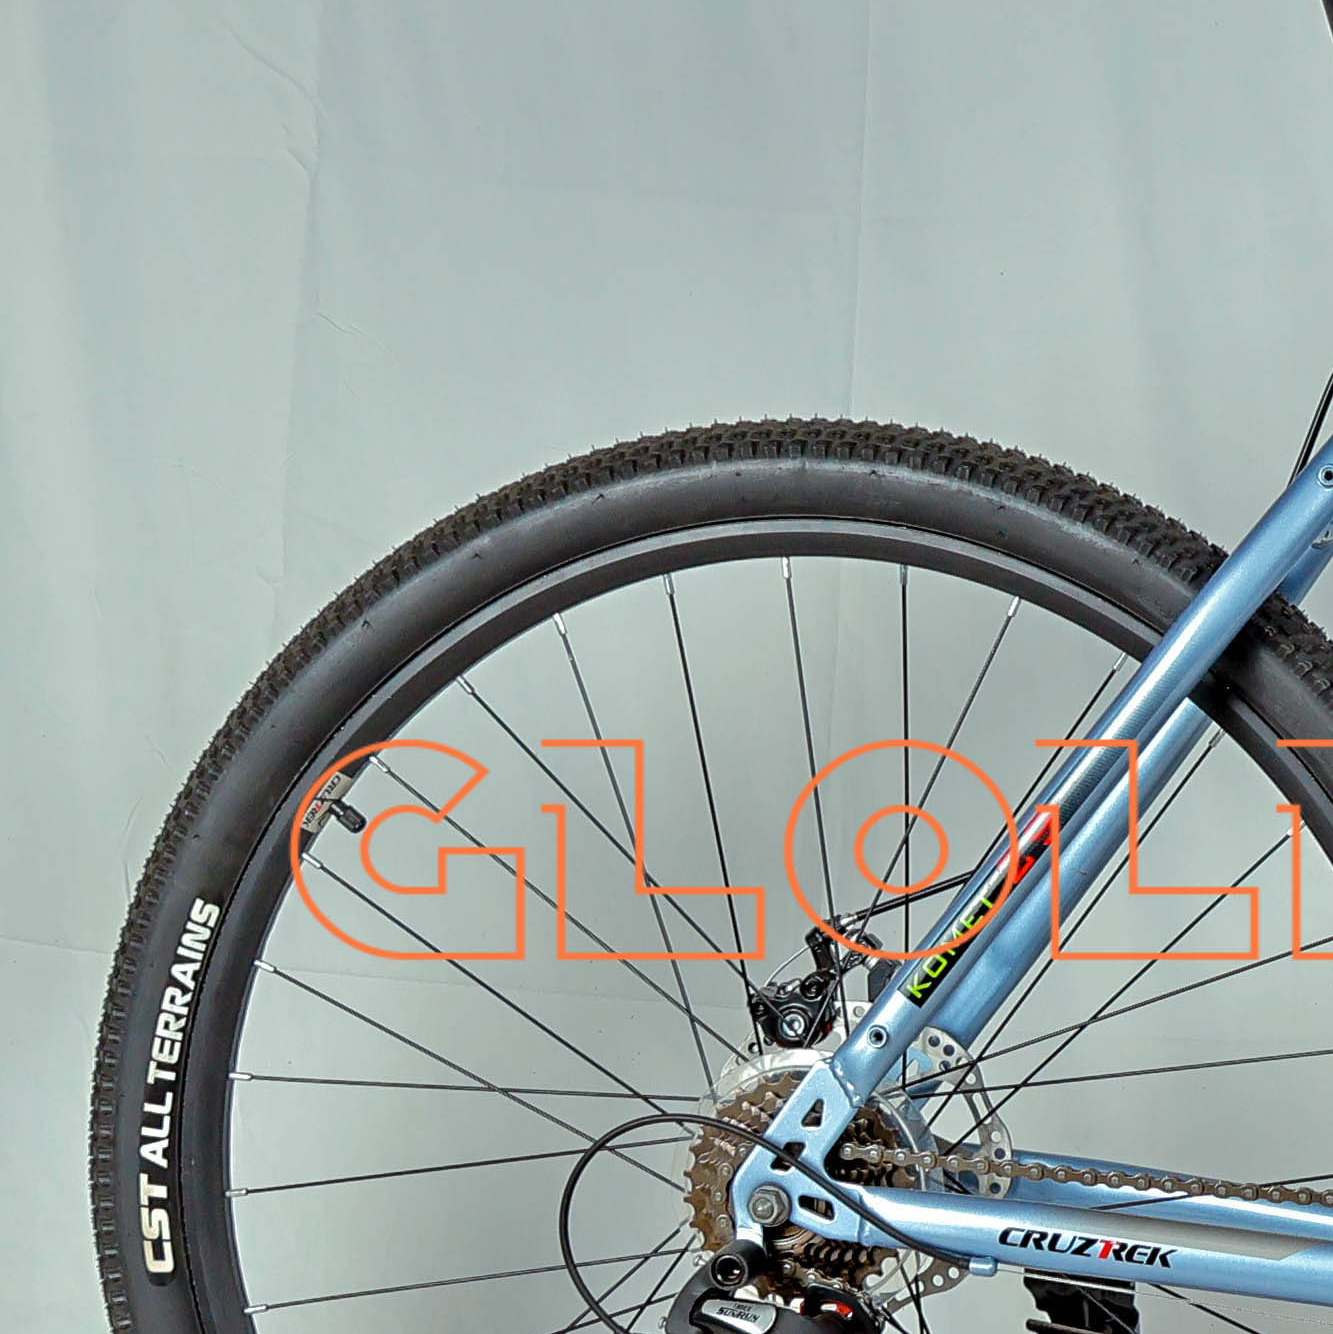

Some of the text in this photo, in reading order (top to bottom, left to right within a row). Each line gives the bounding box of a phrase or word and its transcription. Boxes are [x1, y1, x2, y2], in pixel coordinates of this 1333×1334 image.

[139, 898, 220, 1273] CST ALL TERRAINS
[998, 1226, 1177, 1268] CRUZTREK
